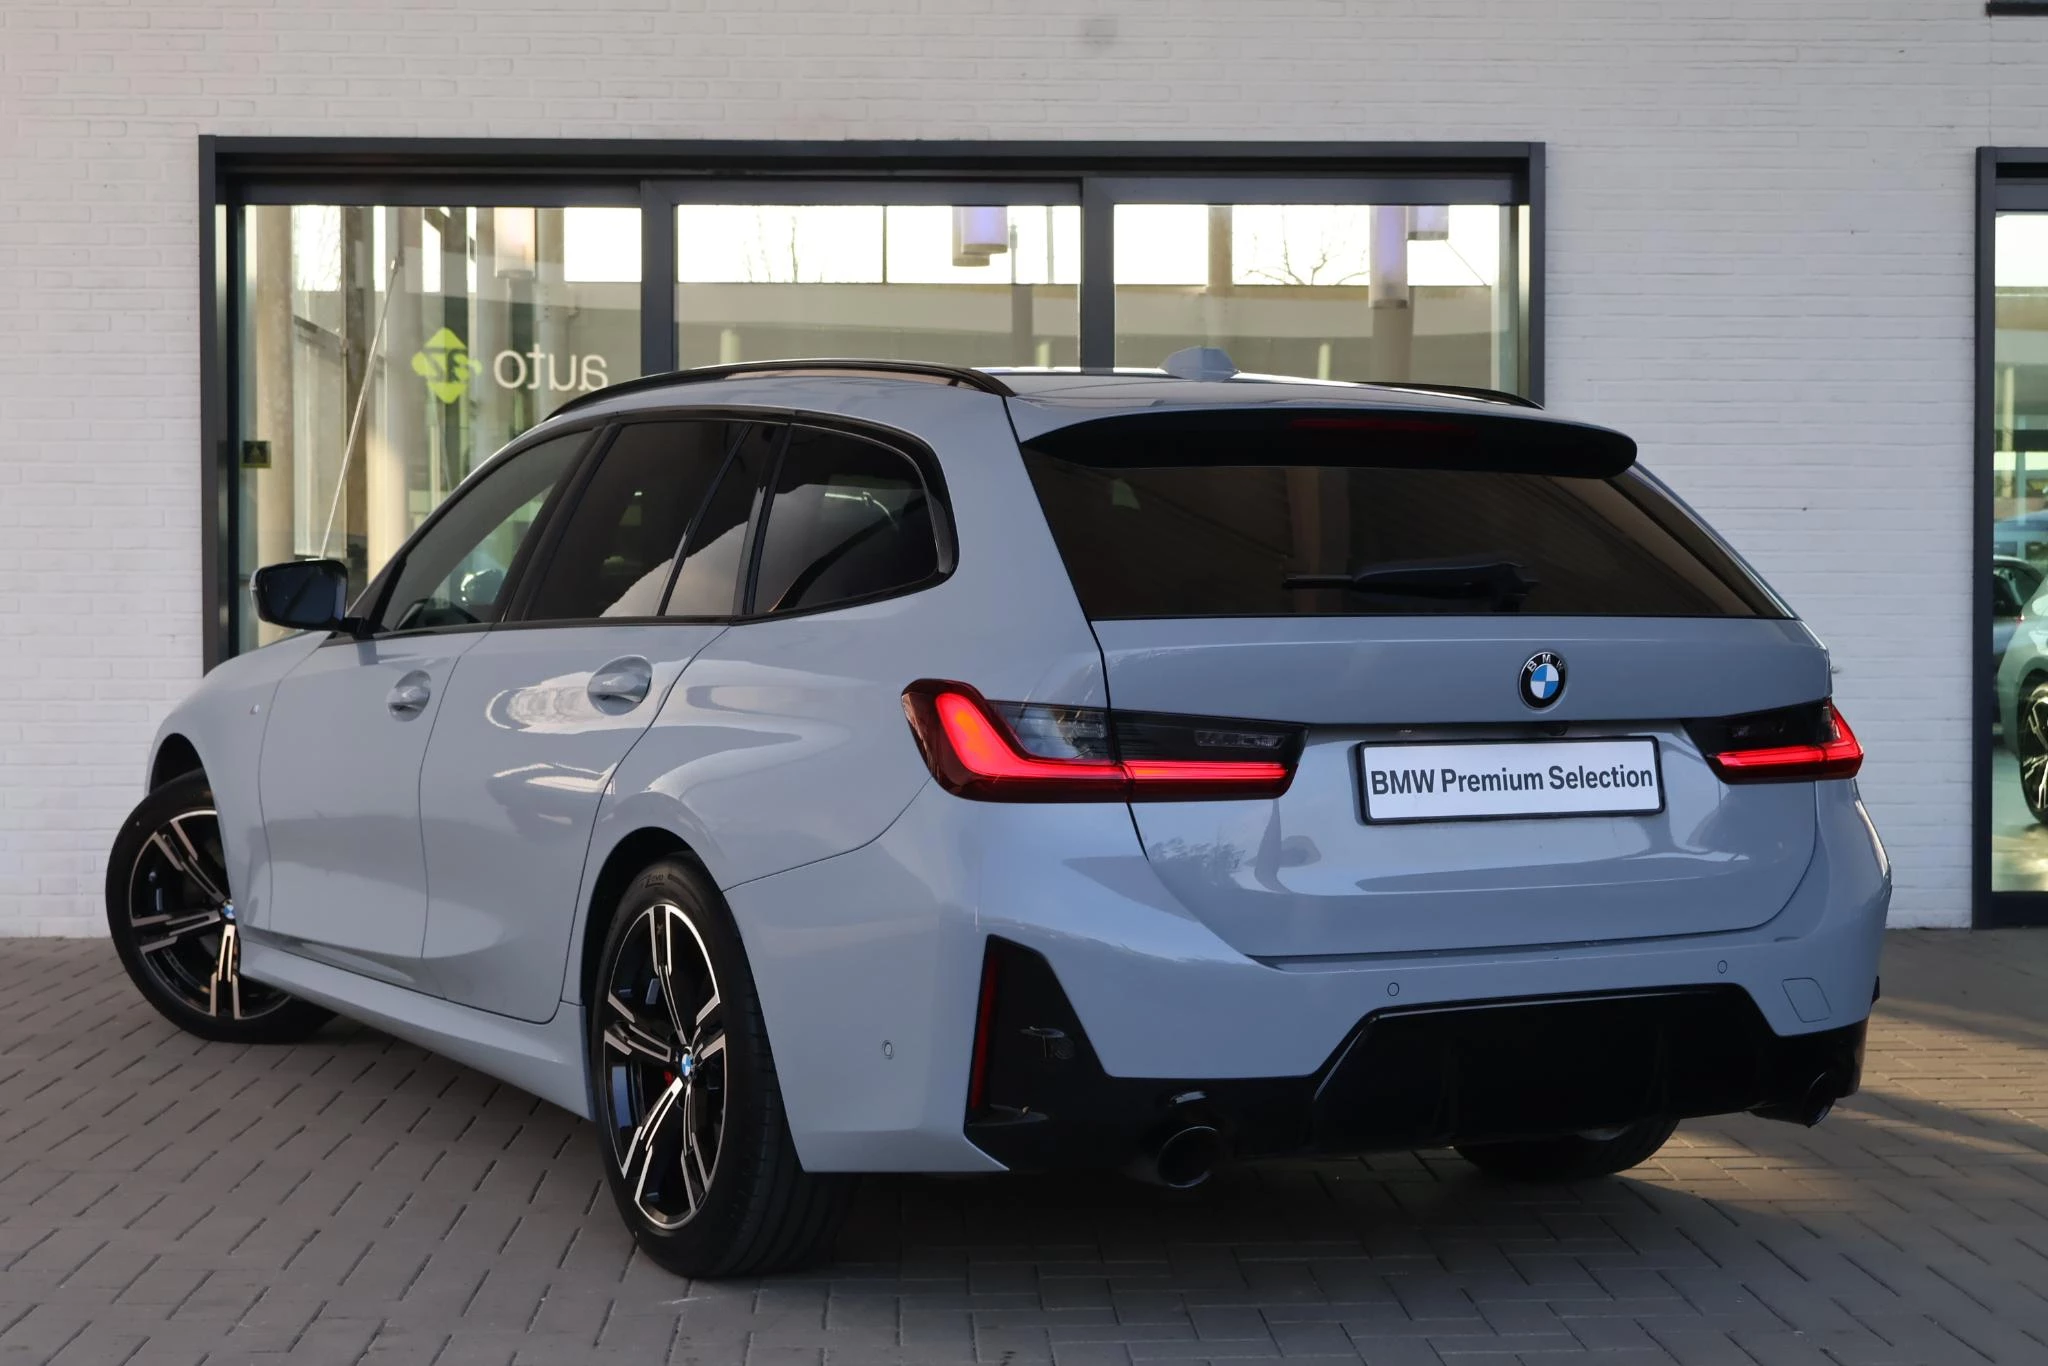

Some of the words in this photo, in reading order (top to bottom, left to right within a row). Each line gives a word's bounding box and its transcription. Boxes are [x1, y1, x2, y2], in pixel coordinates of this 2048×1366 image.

[1527, 653, 1564, 673] BMW
[1371, 768, 1435, 795] BMW
[1442, 767, 1544, 793] Premium
[1549, 764, 1653, 791] Selection
